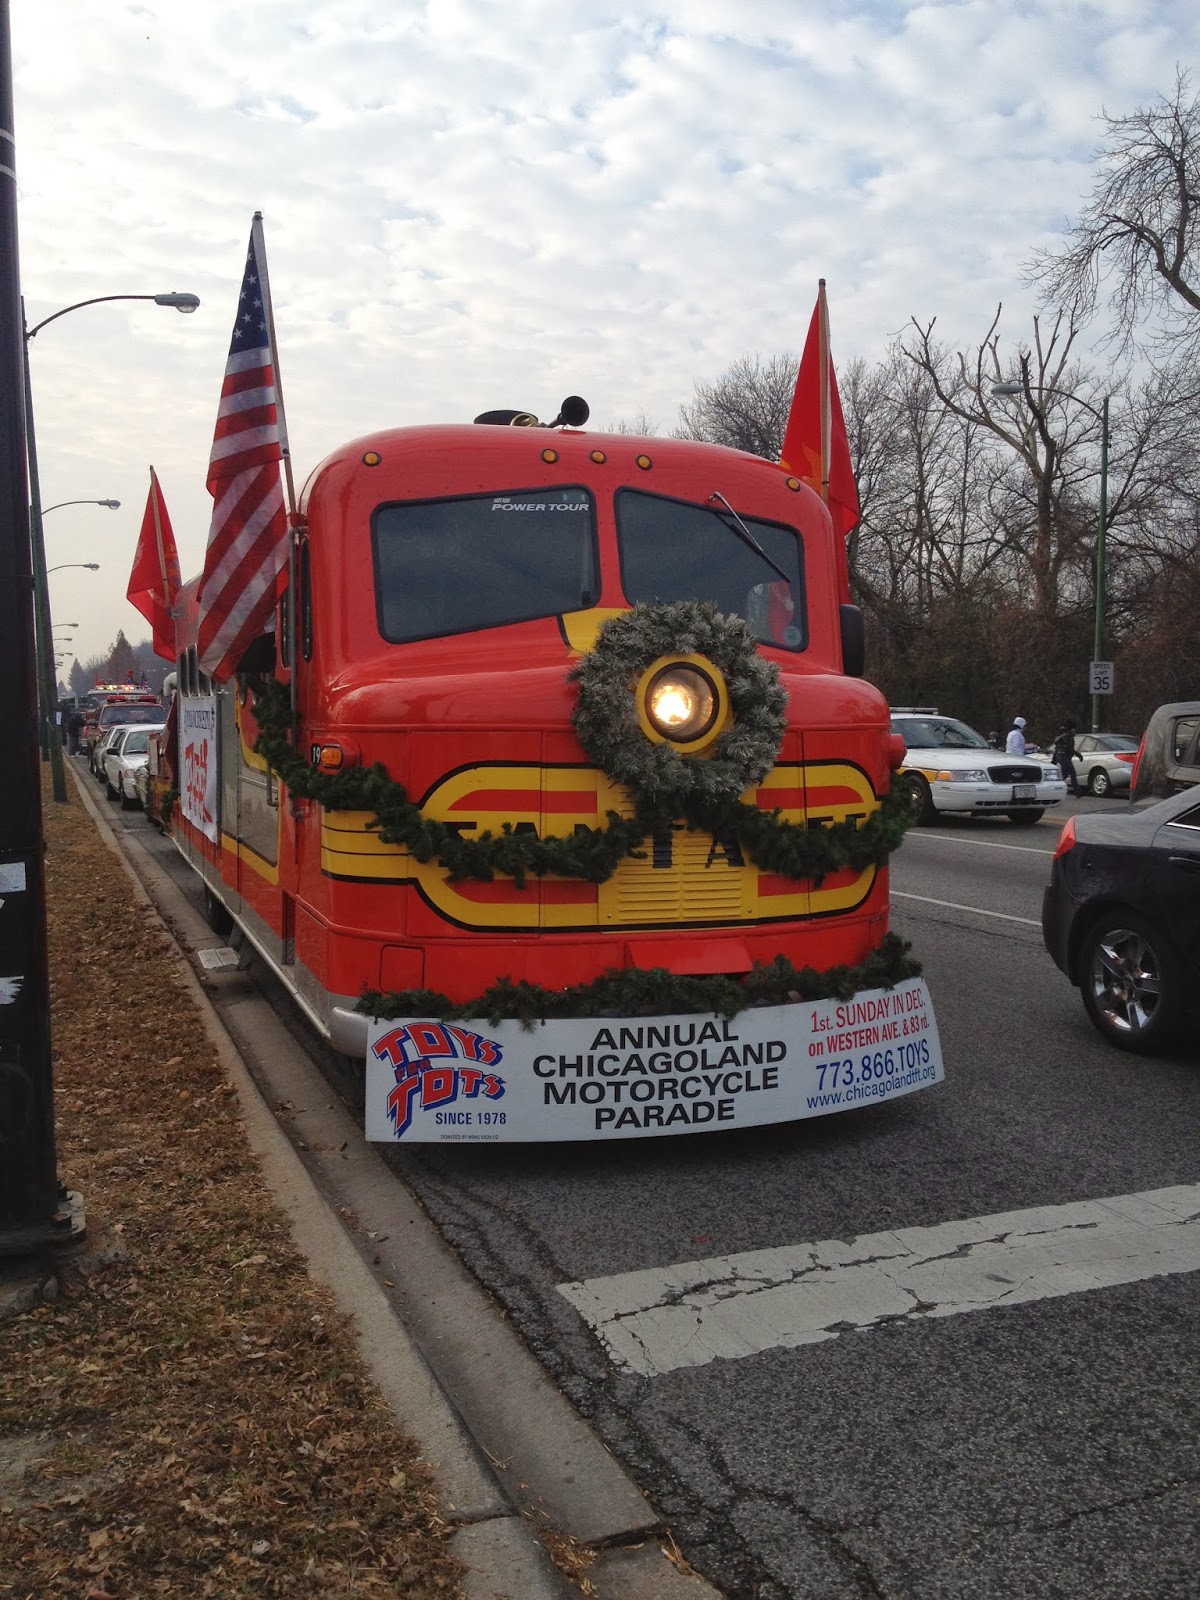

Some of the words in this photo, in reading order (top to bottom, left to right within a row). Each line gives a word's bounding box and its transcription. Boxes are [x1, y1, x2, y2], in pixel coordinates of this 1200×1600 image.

[491, 503, 546, 511] POWER
[549, 503, 589, 511] TOUR
[1093, 676, 1110, 690] 35
[811, 1010, 834, 1033] 1st.
[835, 997, 891, 1028] SUNDAY
[893, 994, 905, 1016] IN
[905, 987, 926, 1012] DEC.
[371, 1022, 504, 1068] TOYS
[589, 1020, 739, 1050] ANNUAL
[808, 1040, 824, 1057] on
[826, 1026, 880, 1053] WESTERN
[881, 1021, 901, 1042] AVE.
[902, 1018, 910, 1036] &
[394, 1058, 433, 1084] FOR
[533, 1040, 787, 1078] CHICAGOLAND
[815, 1038, 930, 1091] 773.866.TOYS
[386, 1067, 507, 1140] TOTS
[543, 1066, 779, 1105] MOTORCYCLE
[806, 1065, 936, 1109] www.chicagolandtft.org
[435, 1112, 472, 1125] SINCE
[477, 1112, 507, 1125] 1978
[595, 1098, 735, 1130] PARADE
